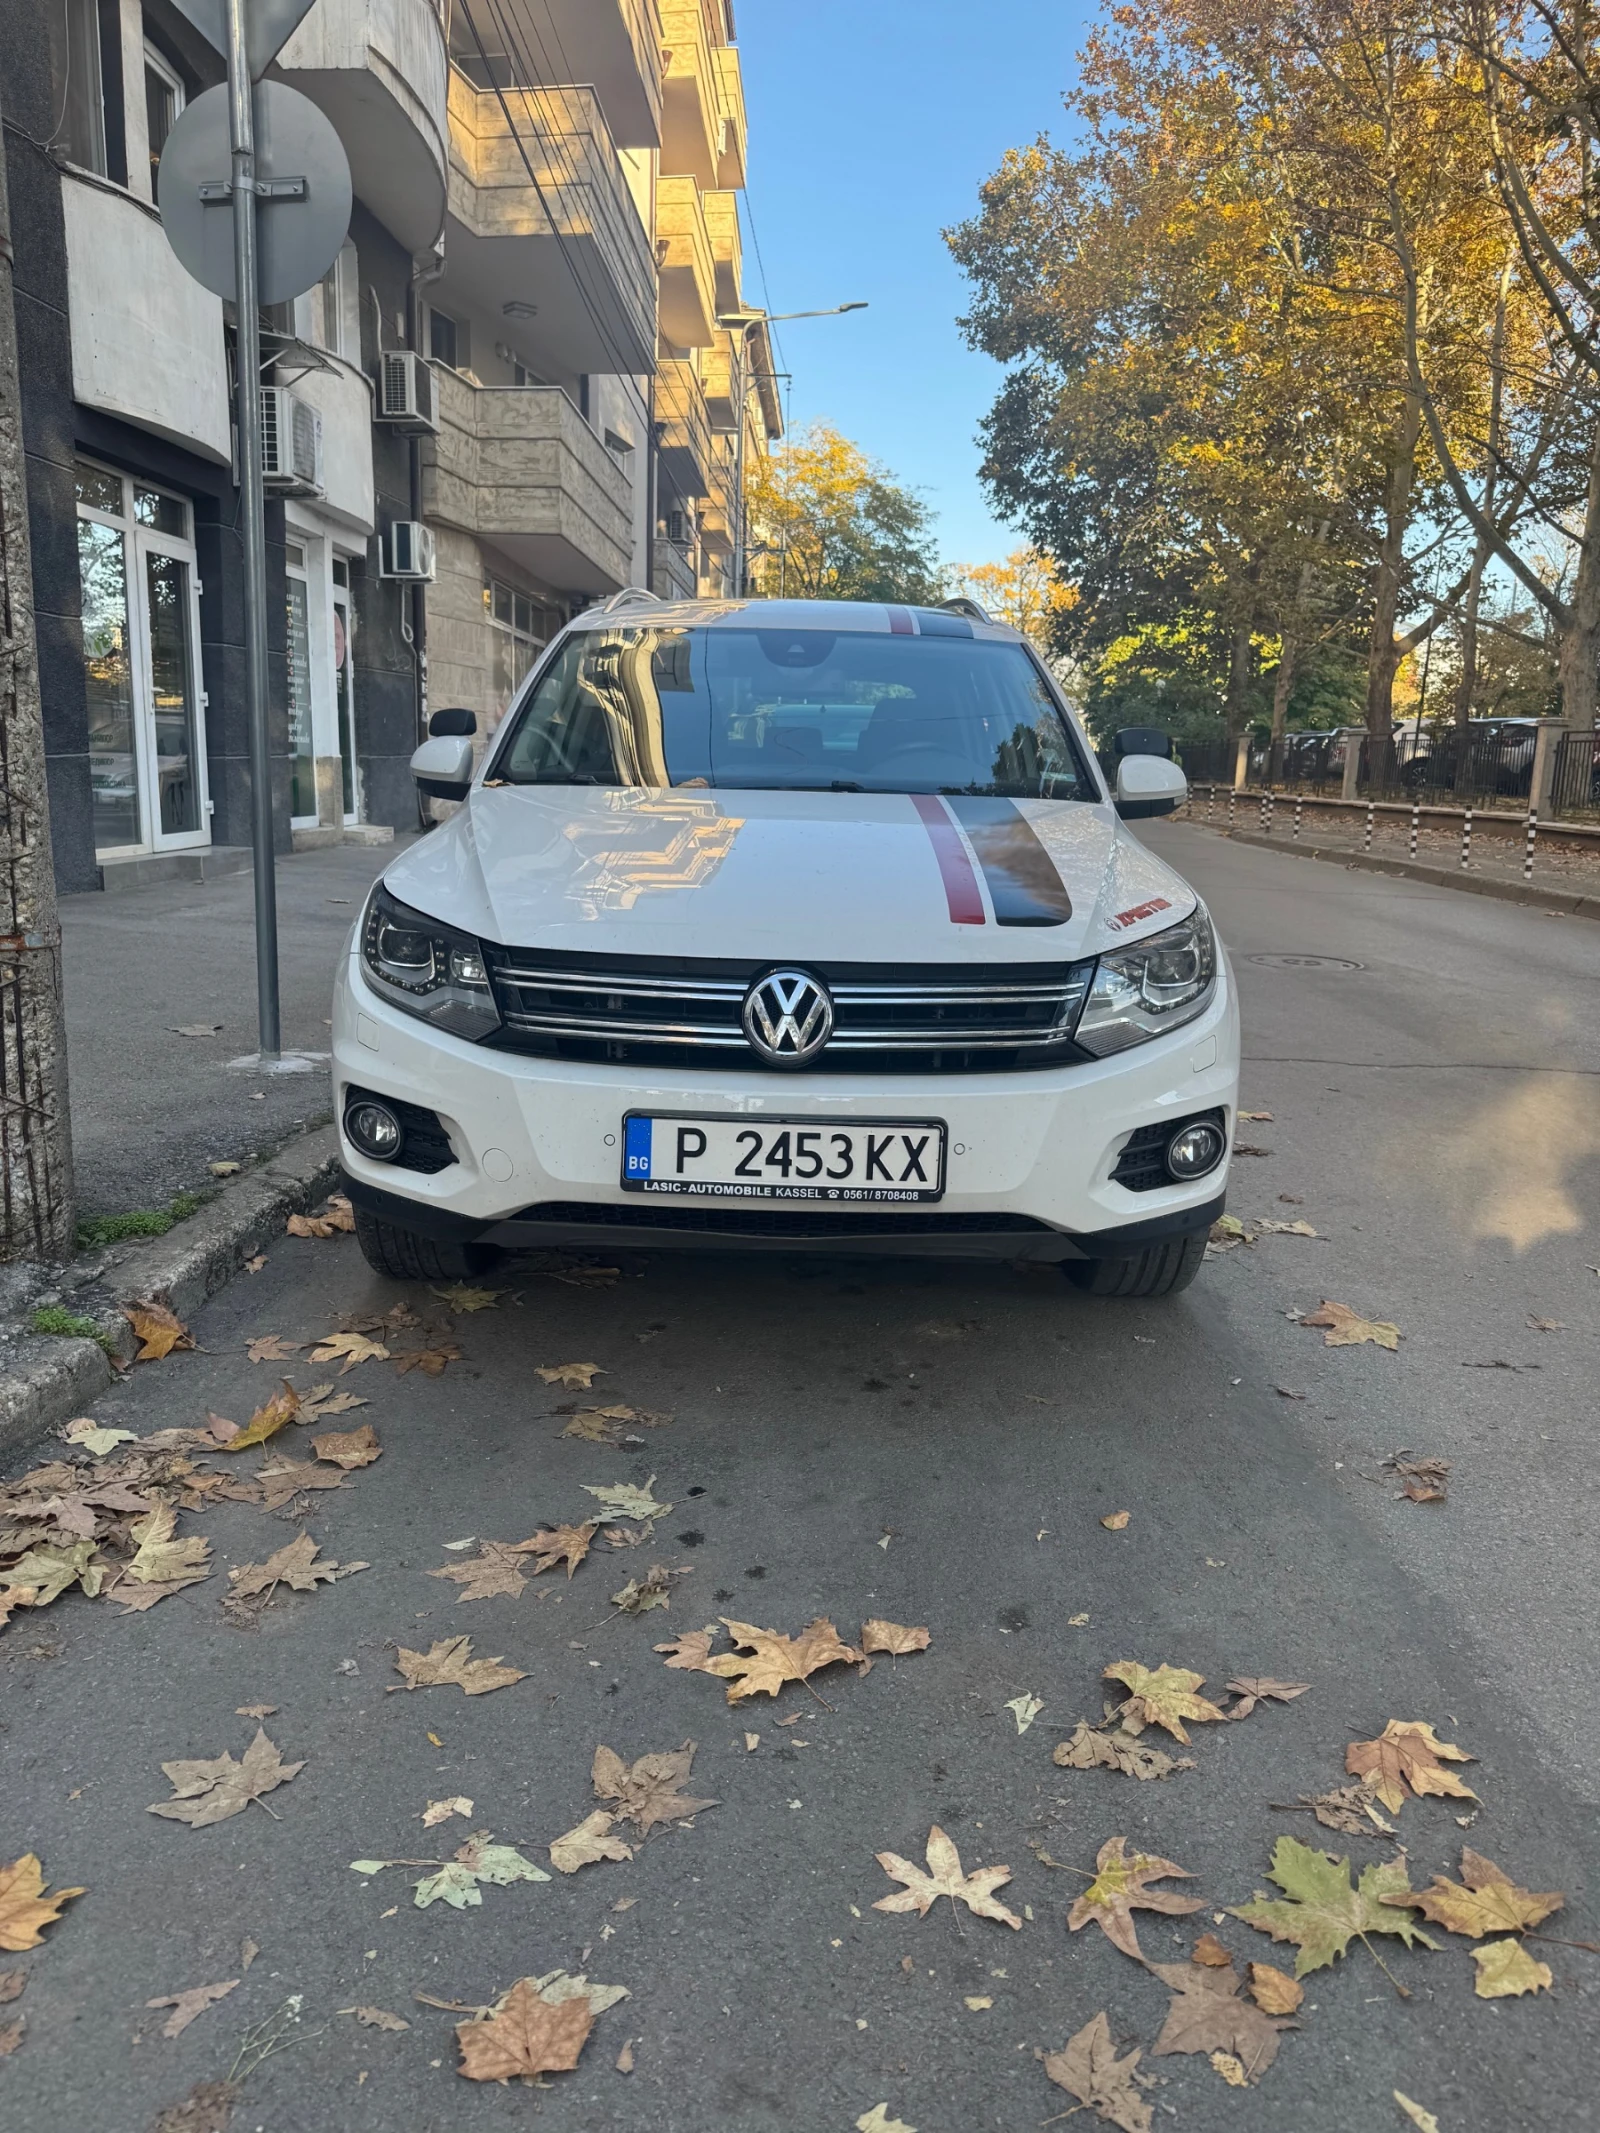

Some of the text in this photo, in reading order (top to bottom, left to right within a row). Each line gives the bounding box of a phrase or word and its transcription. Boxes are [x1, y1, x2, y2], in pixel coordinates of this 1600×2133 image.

[745, 971, 831, 1056] VW
[628, 1155, 649, 1171] BG
[675, 1126, 707, 1174] P
[734, 1130, 854, 1180] 2453
[775, 1187, 822, 1199] KASSEL
